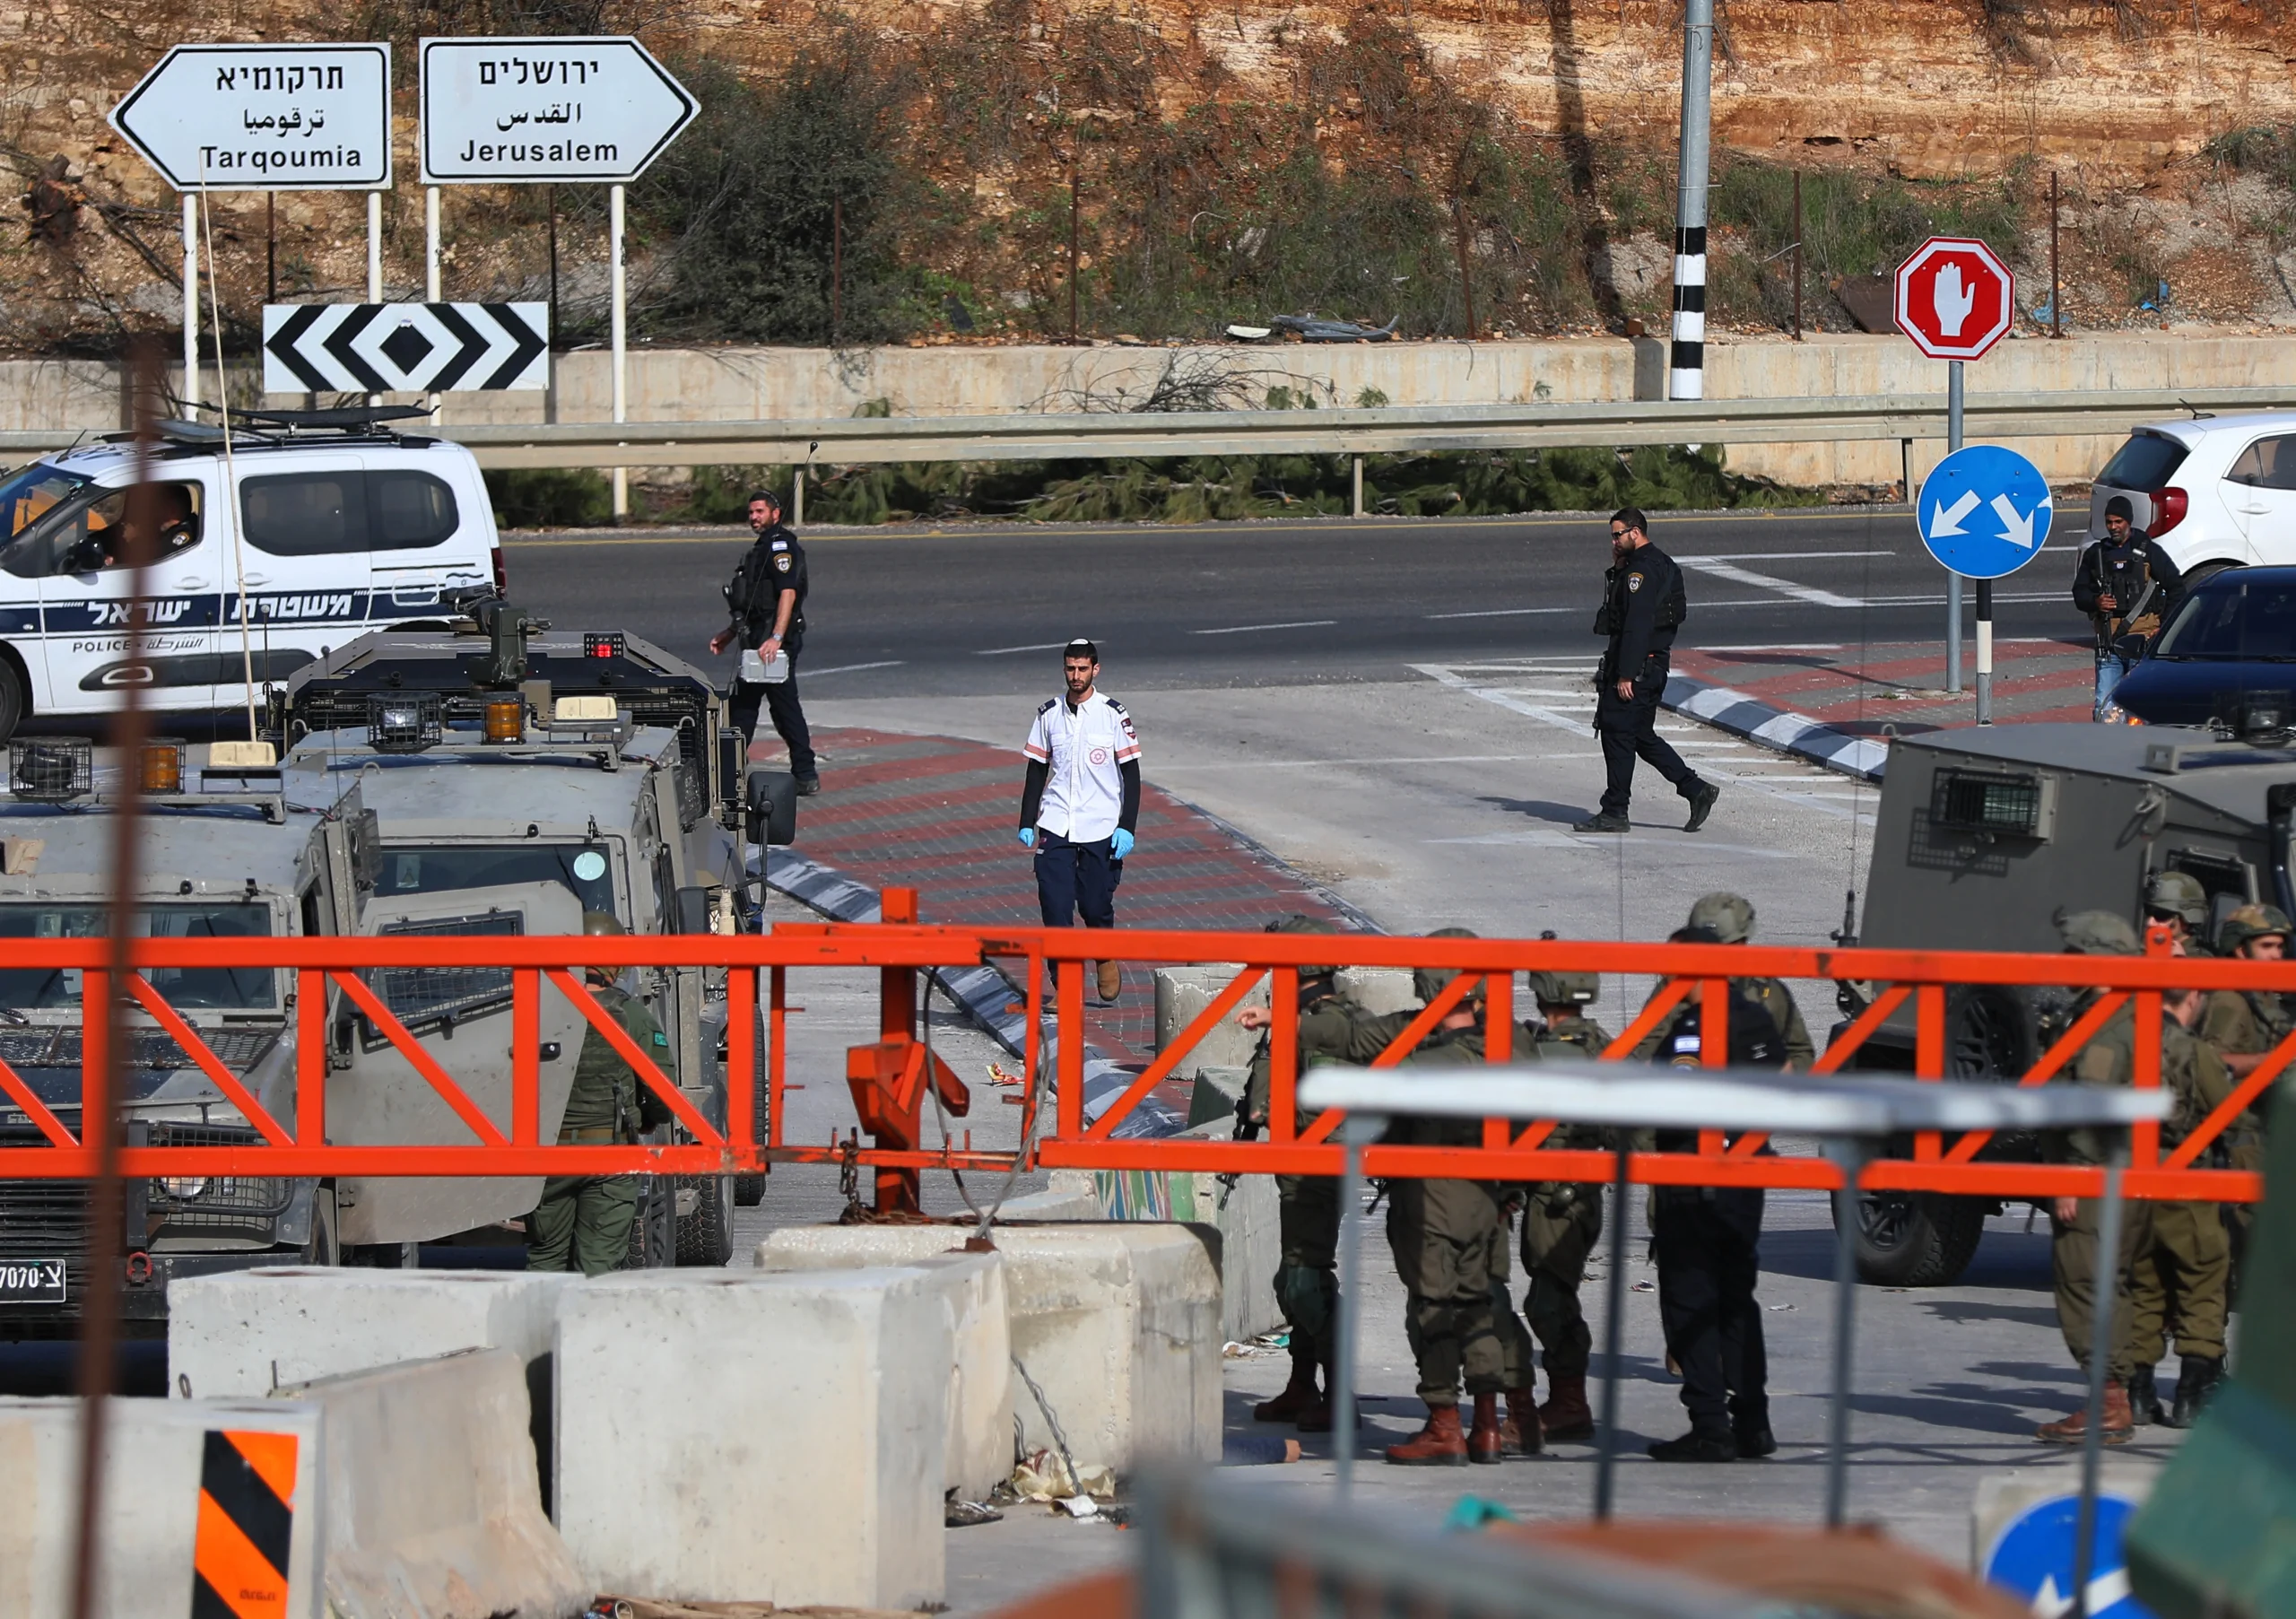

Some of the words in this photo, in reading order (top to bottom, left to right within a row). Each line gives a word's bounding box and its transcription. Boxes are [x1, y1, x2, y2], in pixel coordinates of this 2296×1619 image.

[216, 65, 344, 94] תרקומיא
[478, 57, 598, 85] ירושלים
[244, 108, 325, 138] ترقوميا
[496, 102, 581, 132] القدس
[200, 144, 361, 174] Tarqoumia
[460, 140, 618, 162] Jerusalem
[87, 600, 191, 625] ישראל
[230, 594, 352, 621] משטרת
[73, 640, 132, 653] POLICE
[146, 634, 204, 652] الشرطة
